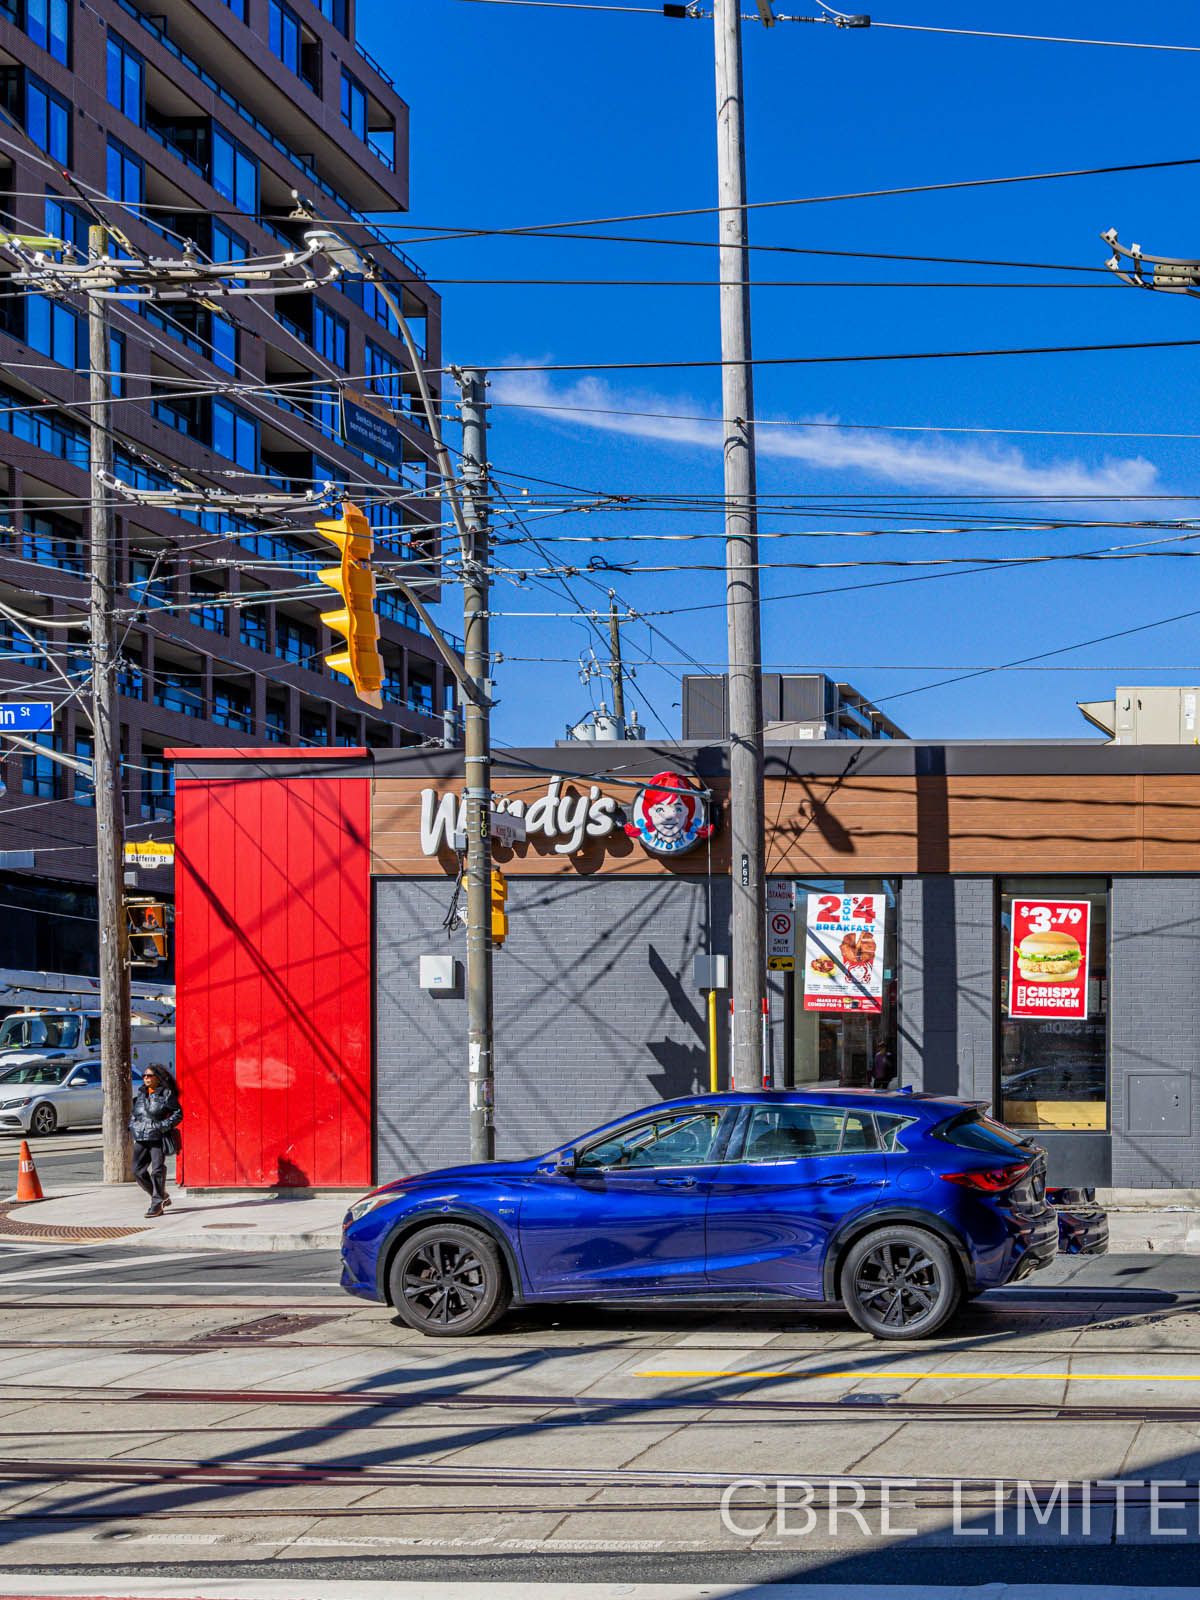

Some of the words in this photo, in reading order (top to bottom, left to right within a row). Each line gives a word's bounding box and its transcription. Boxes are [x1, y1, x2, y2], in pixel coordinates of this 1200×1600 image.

[20, 706, 31, 717] St
[816, 895, 842, 923] 2
[852, 896, 876, 923] $4
[1020, 905, 1082, 934] $3.79
[815, 923, 876, 932] BREAKFAST
[1026, 986, 1080, 998] CRISPY
[1026, 997, 1080, 1008] CHICKEN
